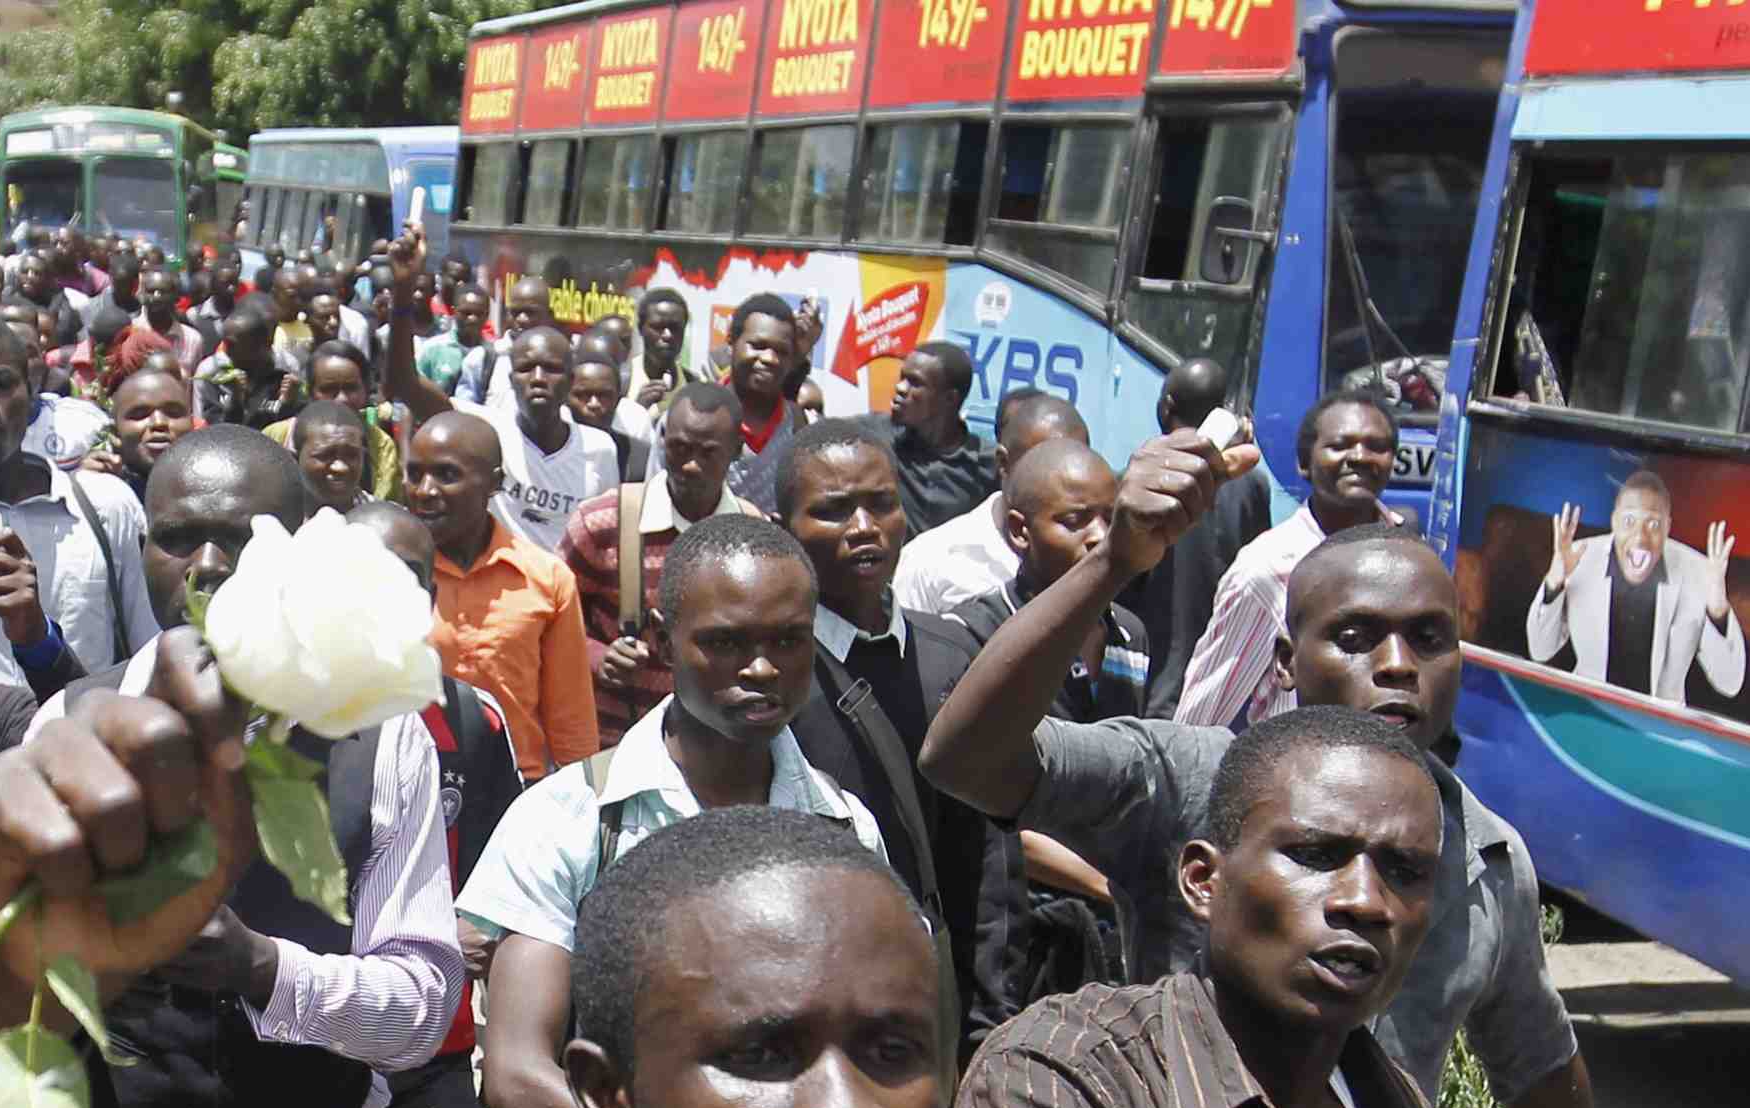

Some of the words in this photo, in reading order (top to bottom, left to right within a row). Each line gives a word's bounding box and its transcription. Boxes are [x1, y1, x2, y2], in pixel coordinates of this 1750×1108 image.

[600, 17, 659, 69] NYOTA
[697, 6, 746, 73] 149/-
[778, 0, 859, 50] NYOTA
[473, 42, 519, 86] NYOTA
[771, 50, 856, 97] BOUQUET
[1018, 22, 1150, 80] BOUQUET
[595, 71, 655, 108] BOUQUET
[964, 334, 1084, 408] KBS
[499, 478, 585, 514] LACOST
